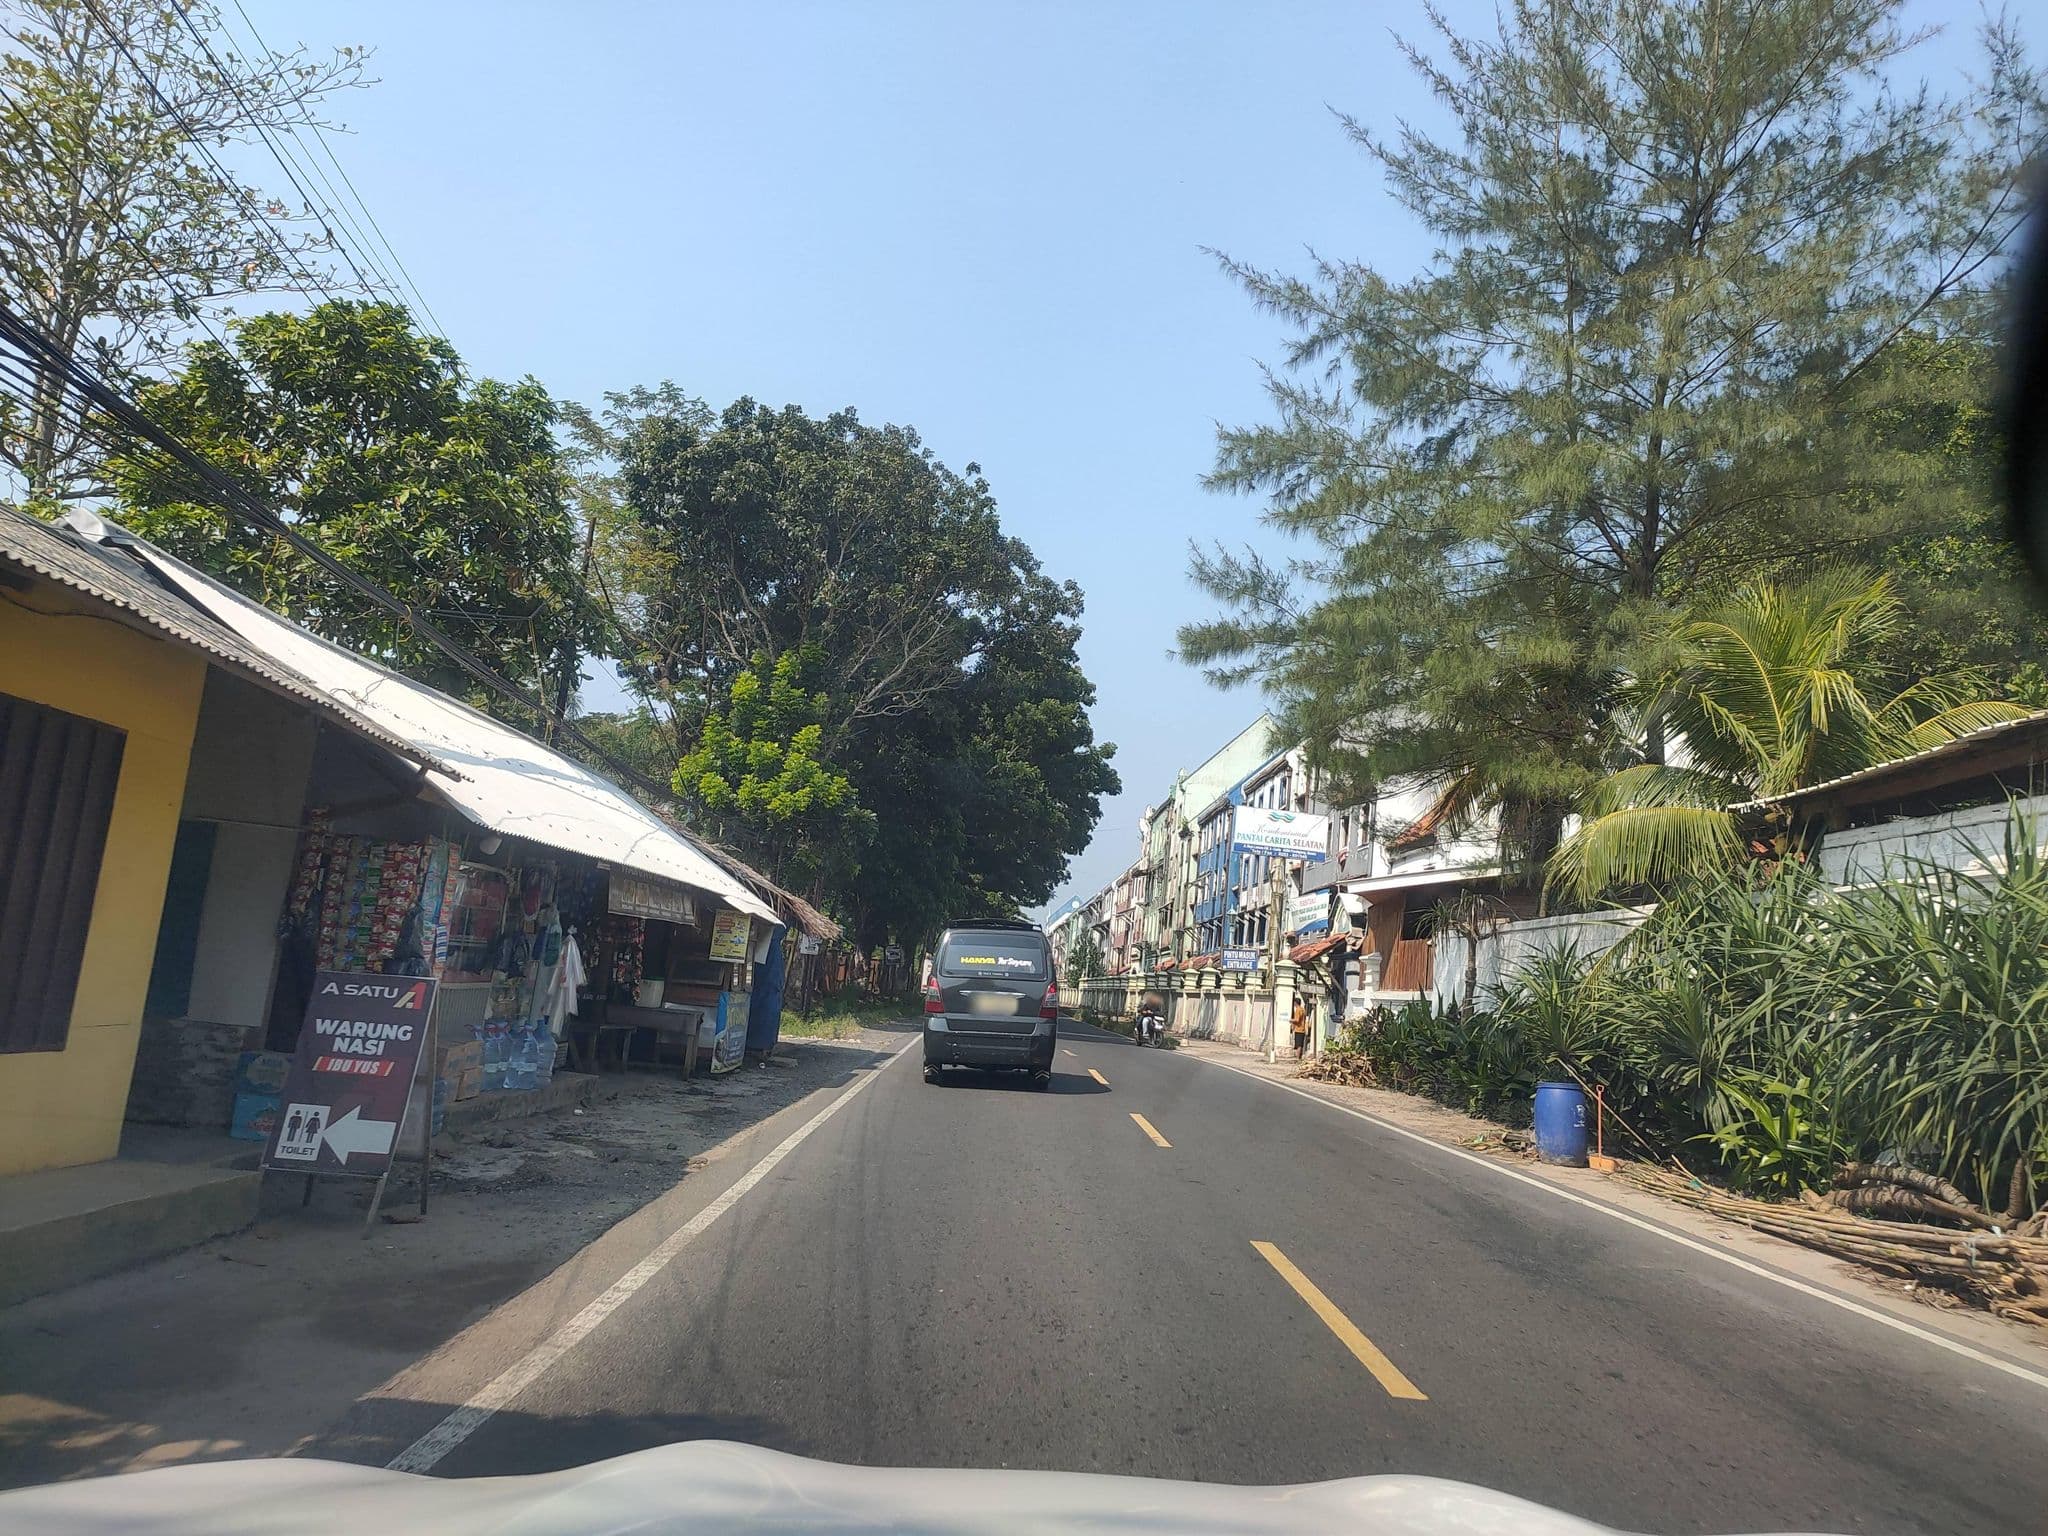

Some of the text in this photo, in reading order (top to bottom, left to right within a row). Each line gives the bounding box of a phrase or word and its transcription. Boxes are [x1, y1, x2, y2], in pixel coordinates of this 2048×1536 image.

[1236, 832, 1263, 842] PANTAI
[1264, 836, 1292, 847] CARITA
[1292, 838, 1325, 851] SELATAN
[1226, 960, 1253, 969] ENTRANCE
[321, 982, 399, 999] A SATU
[315, 1018, 413, 1041] WARUNG
[332, 1036, 386, 1056] NASI
[326, 1058, 380, 1075] IBU YUS
[280, 1145, 316, 1156] TOILET
